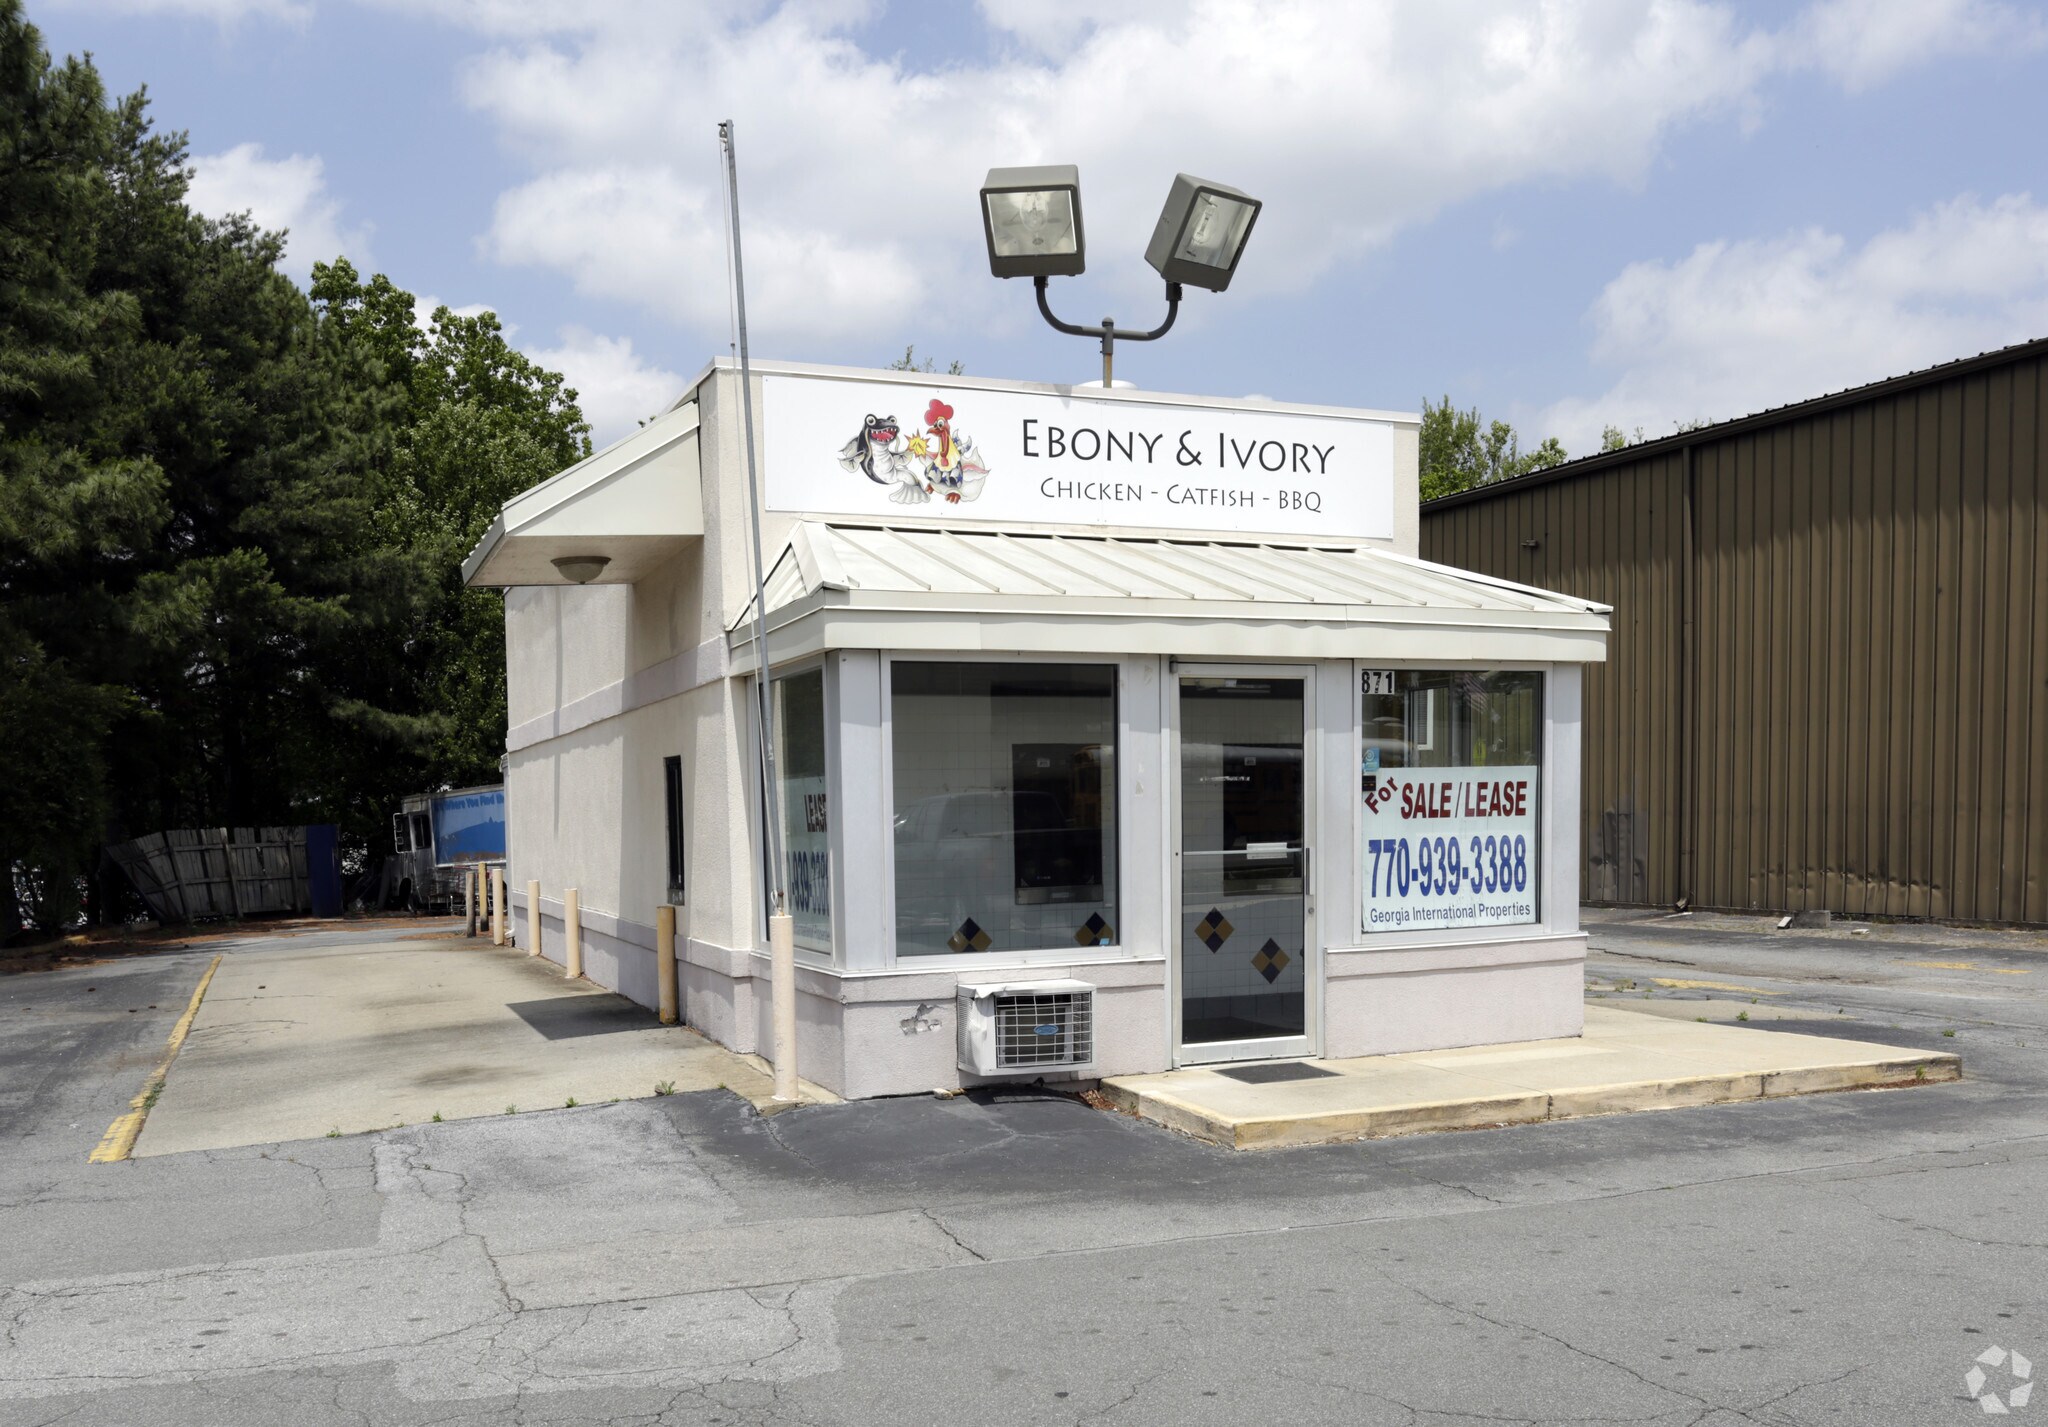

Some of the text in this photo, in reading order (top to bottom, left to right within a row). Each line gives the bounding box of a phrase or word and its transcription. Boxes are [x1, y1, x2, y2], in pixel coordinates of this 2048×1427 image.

[1176, 429, 1202, 466] &
[1279, 490, 1321, 514] BBQ
[1361, 671, 1393, 694] 871
[1364, 776, 1398, 815] For
[1368, 834, 1527, 898] 770-939-3388
[1370, 902, 1531, 926] Georgia International Properties
